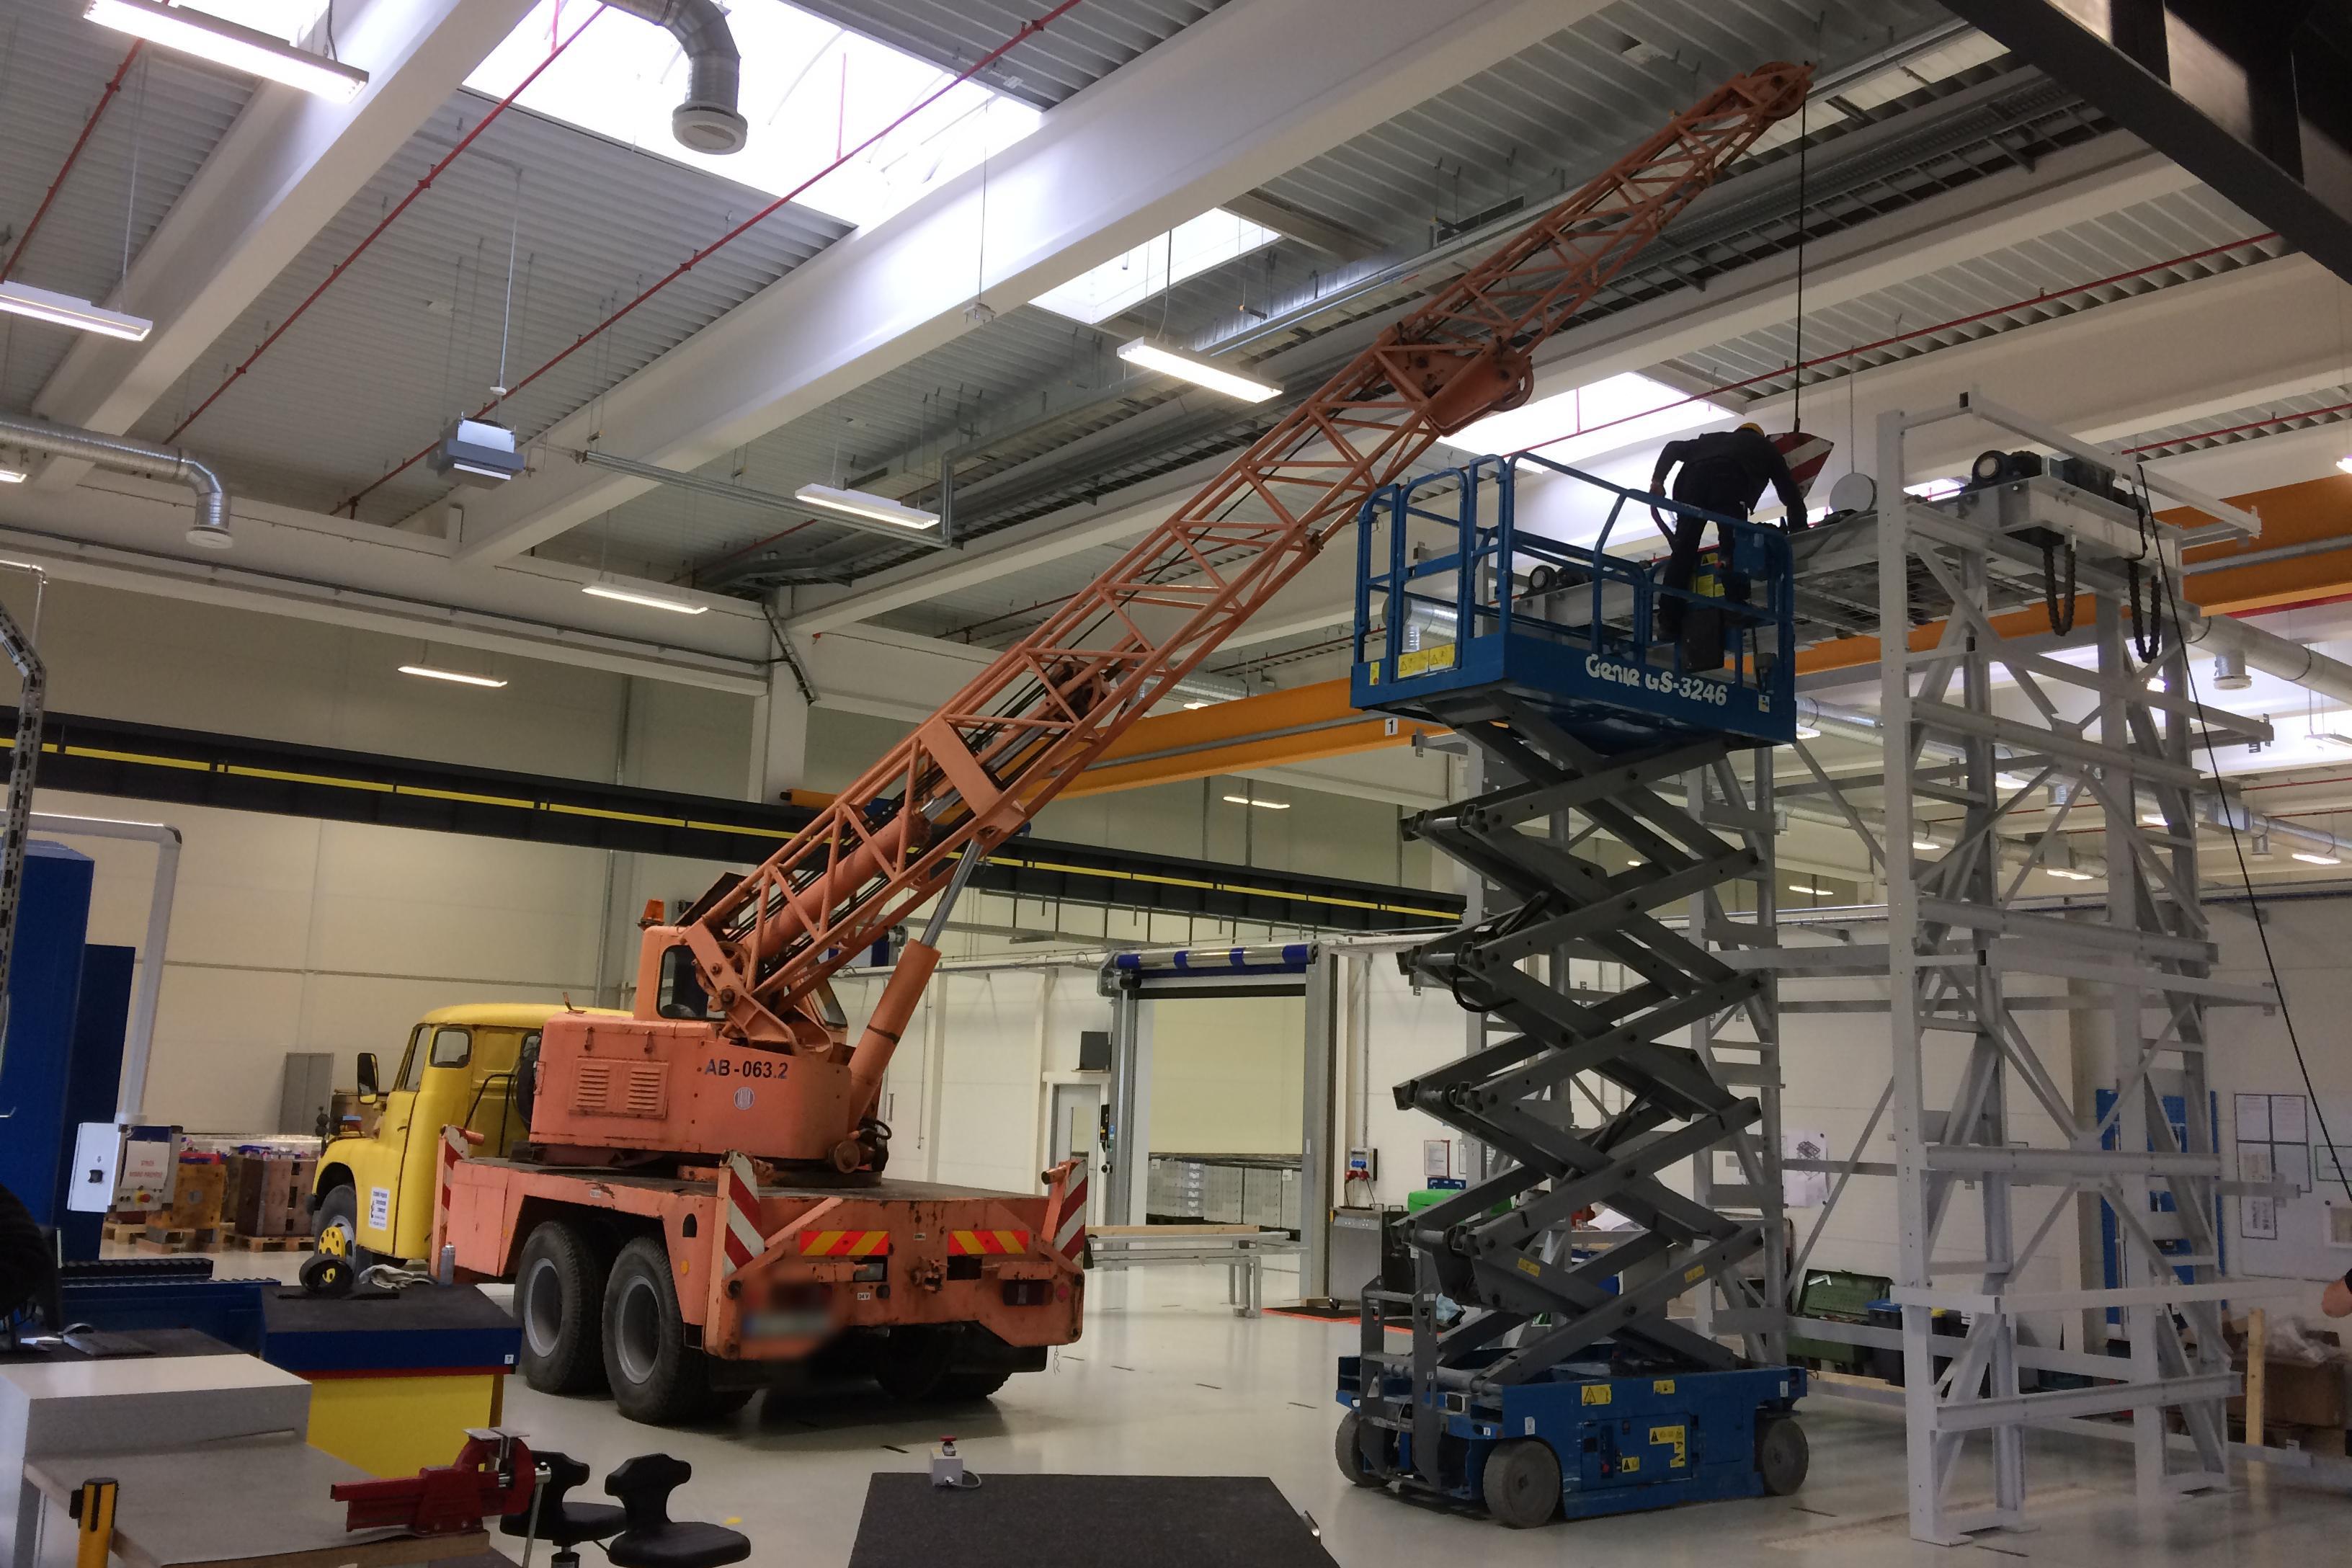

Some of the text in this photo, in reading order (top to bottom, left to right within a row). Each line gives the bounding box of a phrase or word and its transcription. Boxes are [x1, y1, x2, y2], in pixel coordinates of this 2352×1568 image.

[1585, 653, 1728, 706] Genie GS-3246
[1388, 718, 1394, 734] 1
